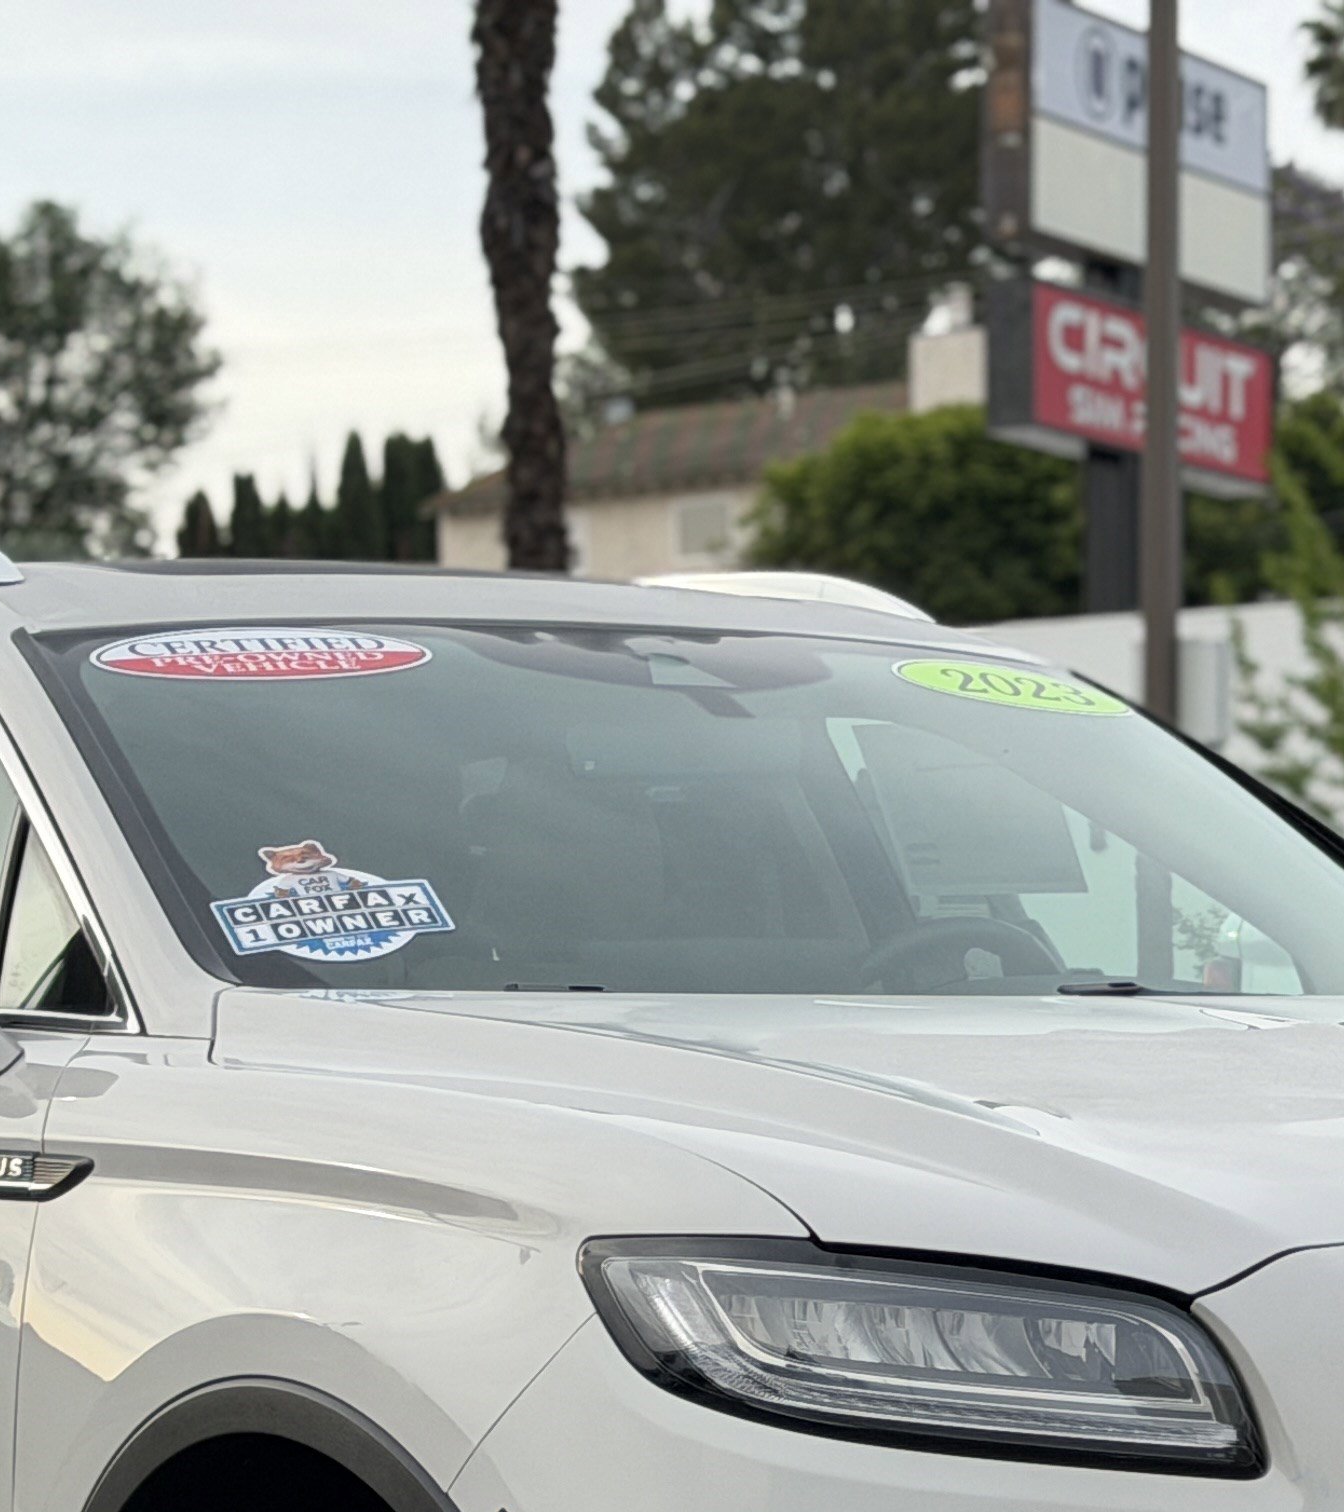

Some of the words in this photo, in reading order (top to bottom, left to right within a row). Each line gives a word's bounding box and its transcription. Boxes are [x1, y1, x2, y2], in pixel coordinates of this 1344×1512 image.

[1047, 300, 1257, 421] CIRUIT
[127, 637, 386, 658] CERTIFIED
[150, 651, 386, 667] PRE-OWNED
[190, 657, 361, 673] VEHICLE
[939, 668, 1096, 706] 2023
[298, 875, 329, 886] CAR
[303, 883, 333, 894] FOX
[233, 891, 426, 923] CARFAX
[276, 909, 434, 939] OWNER
